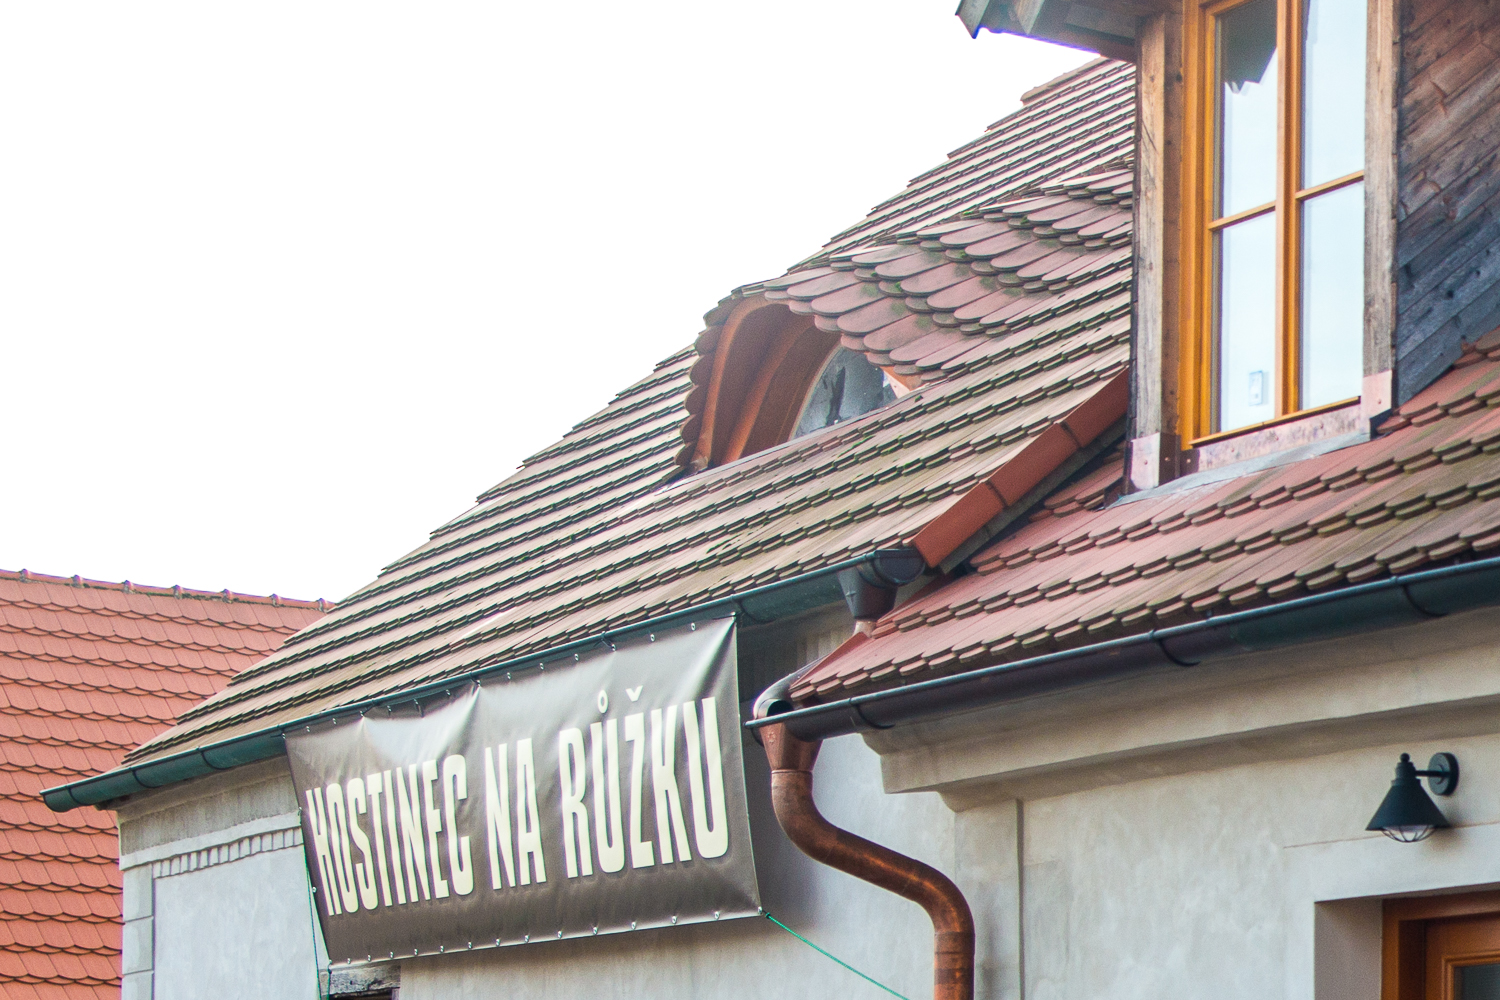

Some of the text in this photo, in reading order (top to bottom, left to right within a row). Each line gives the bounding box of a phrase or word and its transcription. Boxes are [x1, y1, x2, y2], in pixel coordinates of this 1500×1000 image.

[306, 685, 729, 916] HOSTINEC NA RŮŽKU
